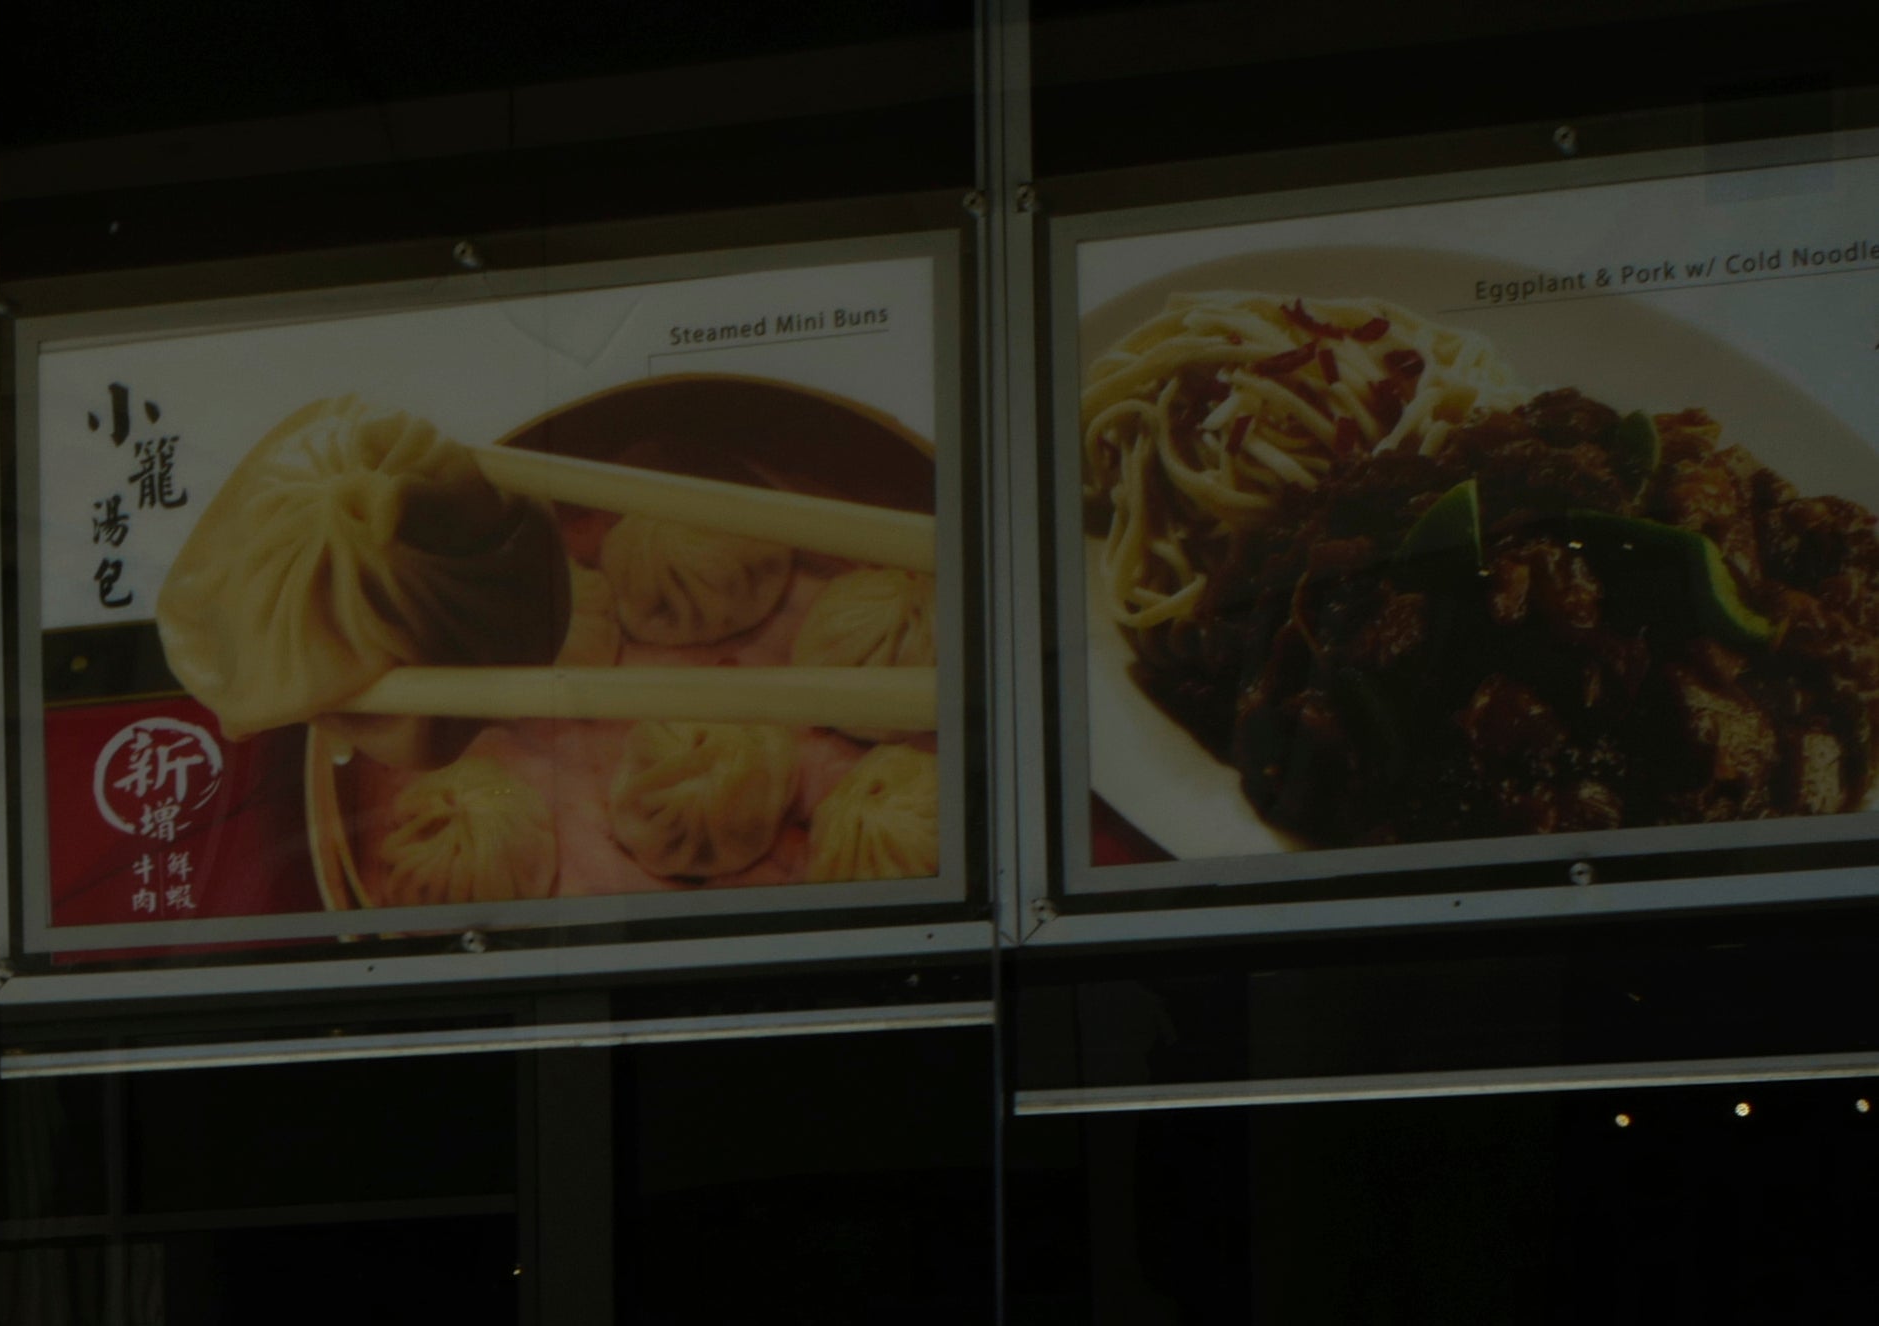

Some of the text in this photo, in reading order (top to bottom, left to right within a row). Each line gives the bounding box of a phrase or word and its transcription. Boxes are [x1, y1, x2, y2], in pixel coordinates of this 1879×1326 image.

[1475, 272, 1585, 304] Eggplant
[1596, 268, 1611, 287] &
[1621, 262, 1675, 284] Pork
[1686, 257, 1717, 278] w/
[1726, 250, 1781, 274] Cold
[670, 307, 888, 346] Steamed Mini Buns
